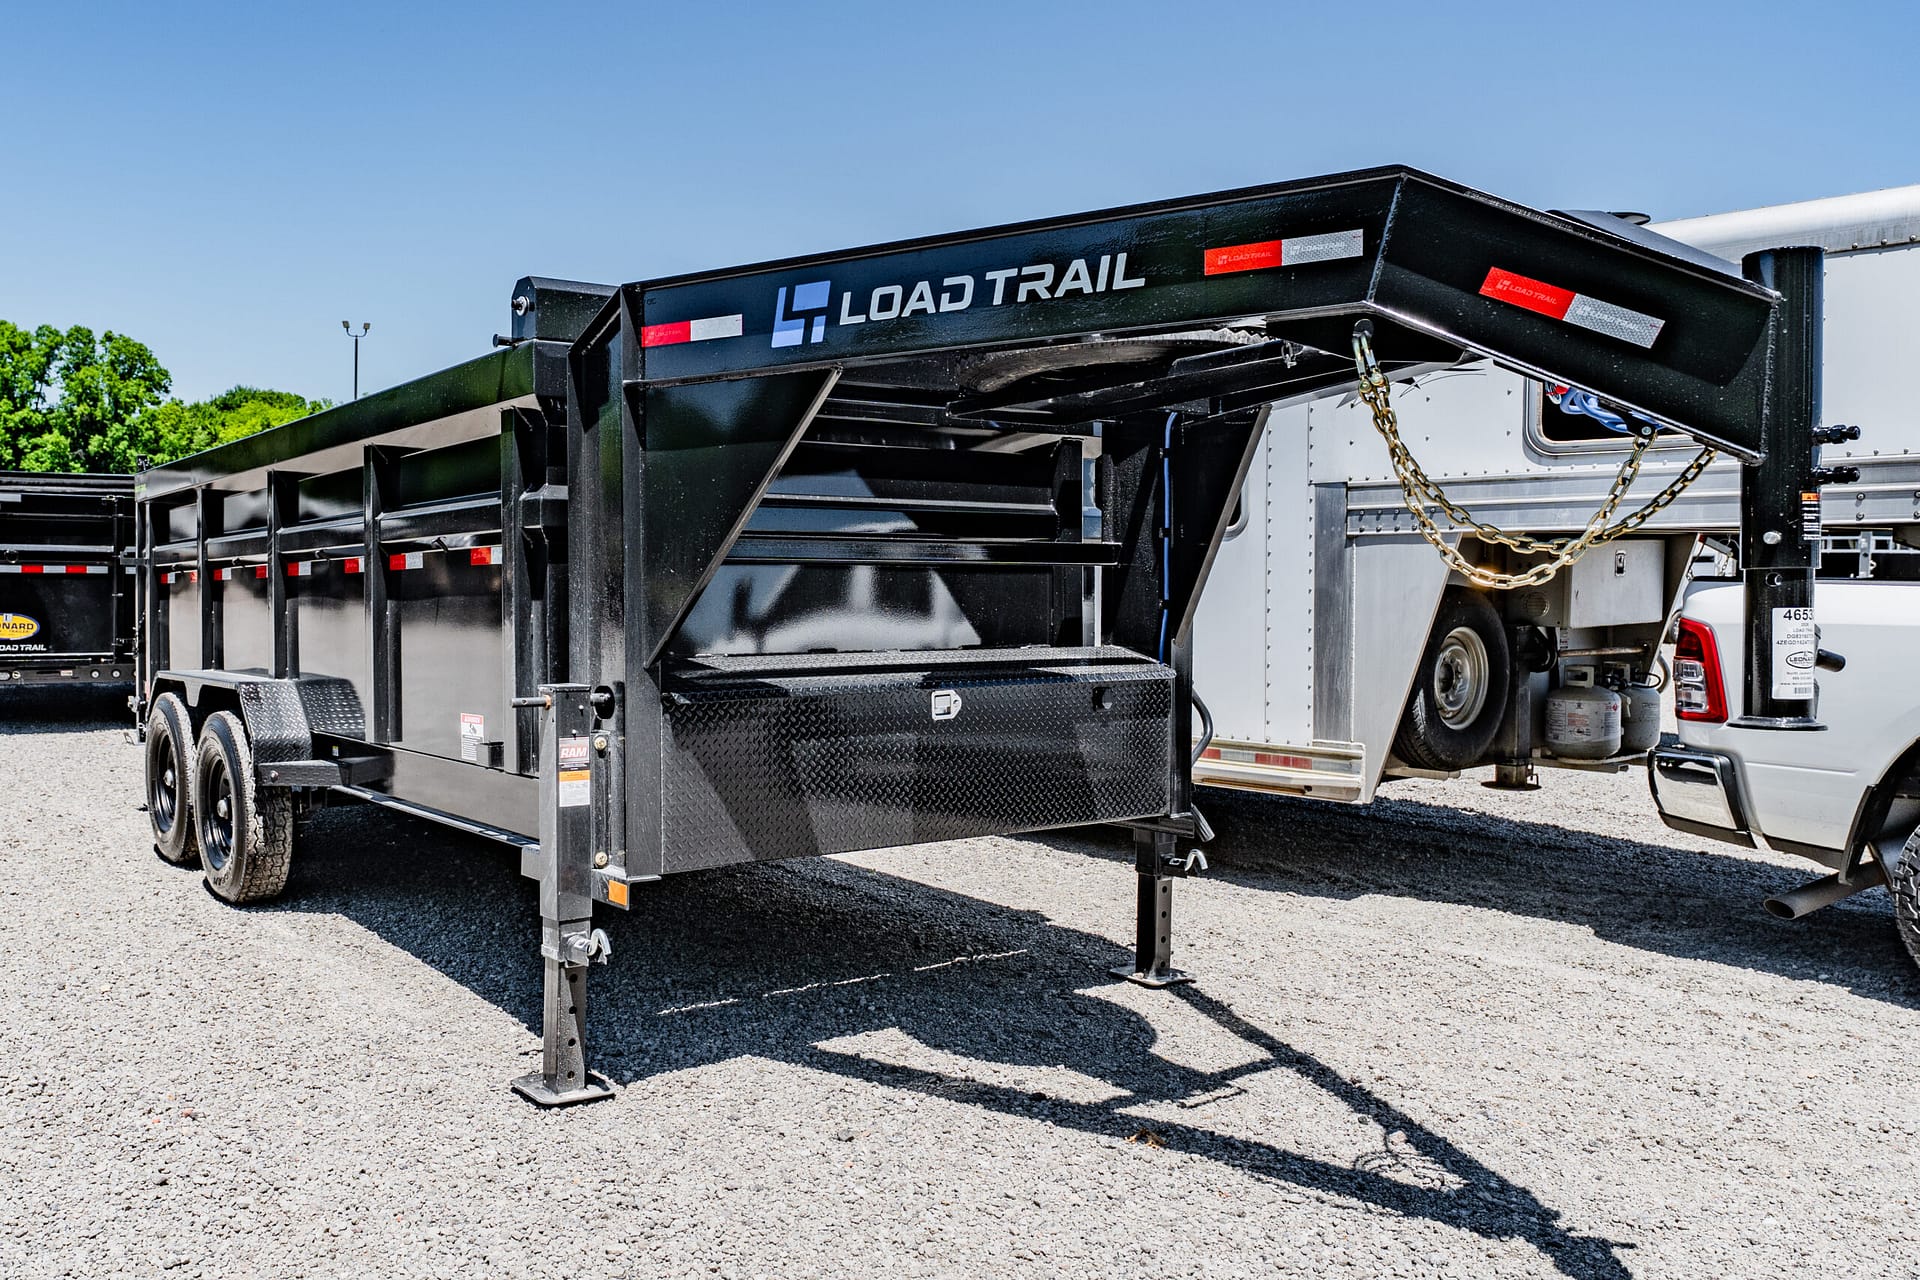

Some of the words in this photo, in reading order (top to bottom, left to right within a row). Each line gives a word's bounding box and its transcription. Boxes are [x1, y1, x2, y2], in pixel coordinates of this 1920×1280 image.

[839, 275, 974, 325] LOAD
[985, 252, 1146, 306] TRAIL
[20, 643, 47, 651] TRAIL
[560, 746, 588, 759] RAM
